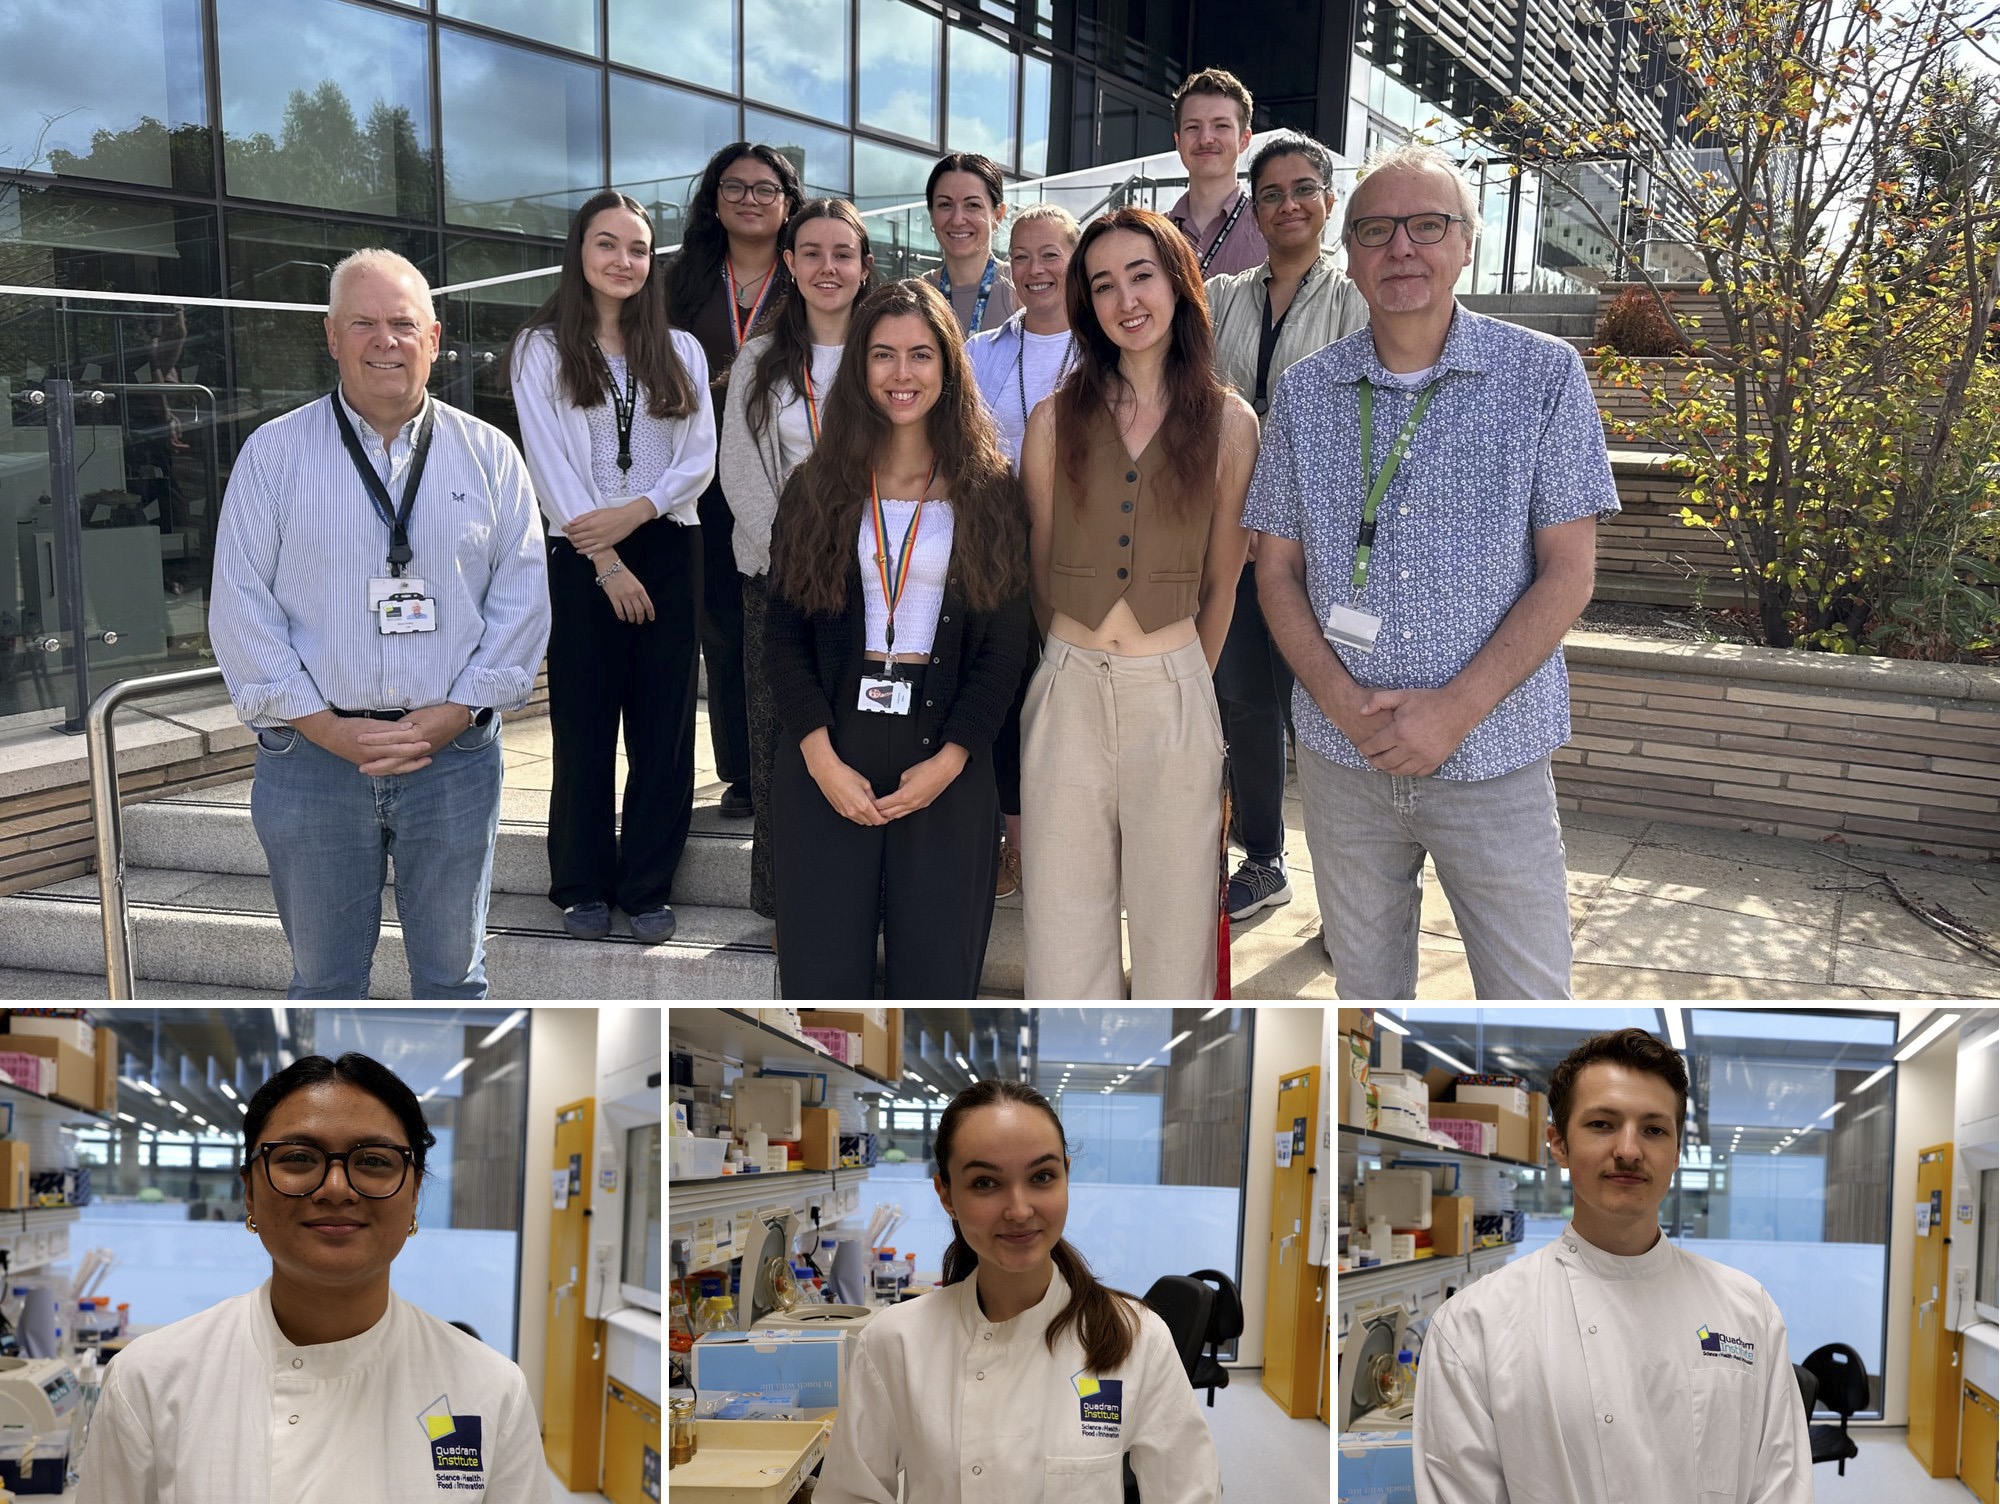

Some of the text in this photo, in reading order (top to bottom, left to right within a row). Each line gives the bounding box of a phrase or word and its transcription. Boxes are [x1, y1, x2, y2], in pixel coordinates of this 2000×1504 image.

[1719, 1333, 1755, 1350] Quadram
[797, 1381, 822, 1390] touch
[1083, 1402, 1119, 1411] Quadram
[1084, 1410, 1119, 1420] Institute
[435, 1445, 478, 1456] Quadram
[437, 1455, 479, 1467] Institute
[436, 1473, 482, 1482] Science Health
[437, 1481, 453, 1489] Food
